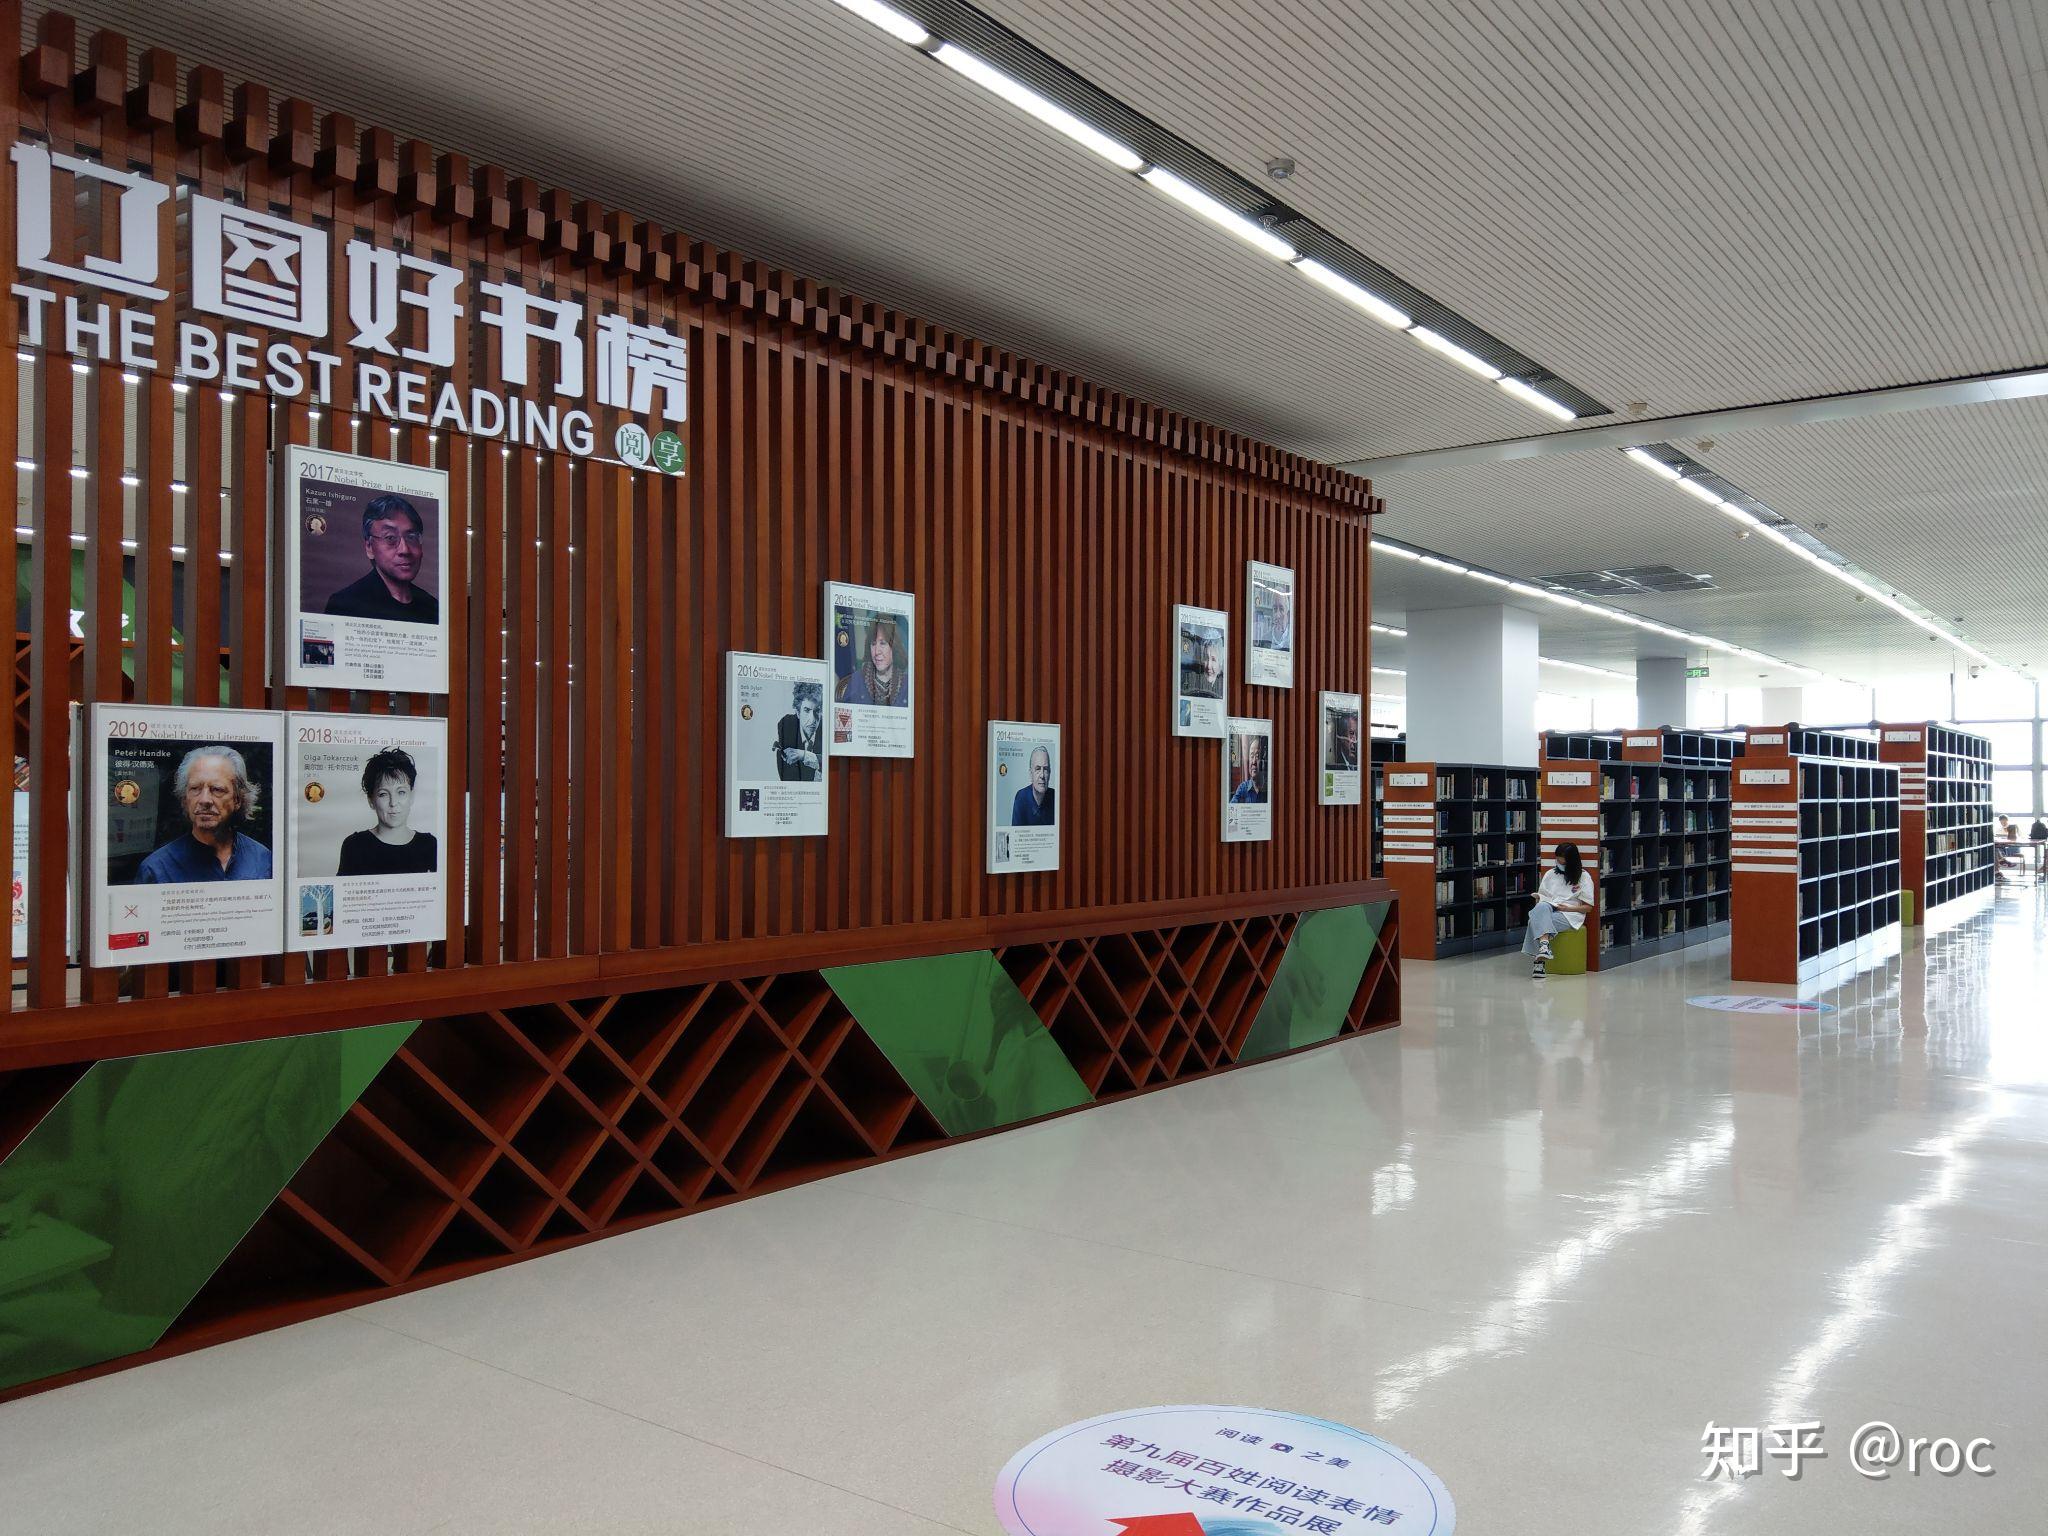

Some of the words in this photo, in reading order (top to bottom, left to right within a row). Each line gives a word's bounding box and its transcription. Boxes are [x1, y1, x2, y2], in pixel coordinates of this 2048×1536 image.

[11, 283, 158, 370] THE
[180, 321, 342, 404] BEST
[359, 363, 595, 457] READING
[300, 461, 334, 481] 2017
[305, 487, 327, 497] Kazuo
[328, 490, 357, 502] Ishiguro
[334, 474, 358, 486] Nobel
[361, 479, 381, 490] Prize
[385, 483, 394, 492] in
[397, 485, 435, 498] Literature
[834, 593, 853, 607] 2015
[737, 664, 759, 678] 2016
[108, 720, 148, 738] 2019
[150, 729, 178, 740] Nobel
[180, 730, 203, 741] Prize
[206, 731, 215, 741] in
[217, 732, 260, 742] Literature
[298, 727, 332, 744] 2018
[333, 735, 358, 745] Nobel
[359, 736, 380, 746] Prize
[114, 749, 137, 757] Peter
[139, 749, 171, 758] Handke
[303, 754, 321, 762] Olga
[322, 754, 359, 762] Tokarczuk
[1215, 1427, 1263, 1446] 阅读
[1301, 1449, 1353, 1470] 之美
[1100, 1432, 1405, 1526] 第九届百姓阅读表情
[1100, 1459, 1343, 1536] 摄影大赛作品展
